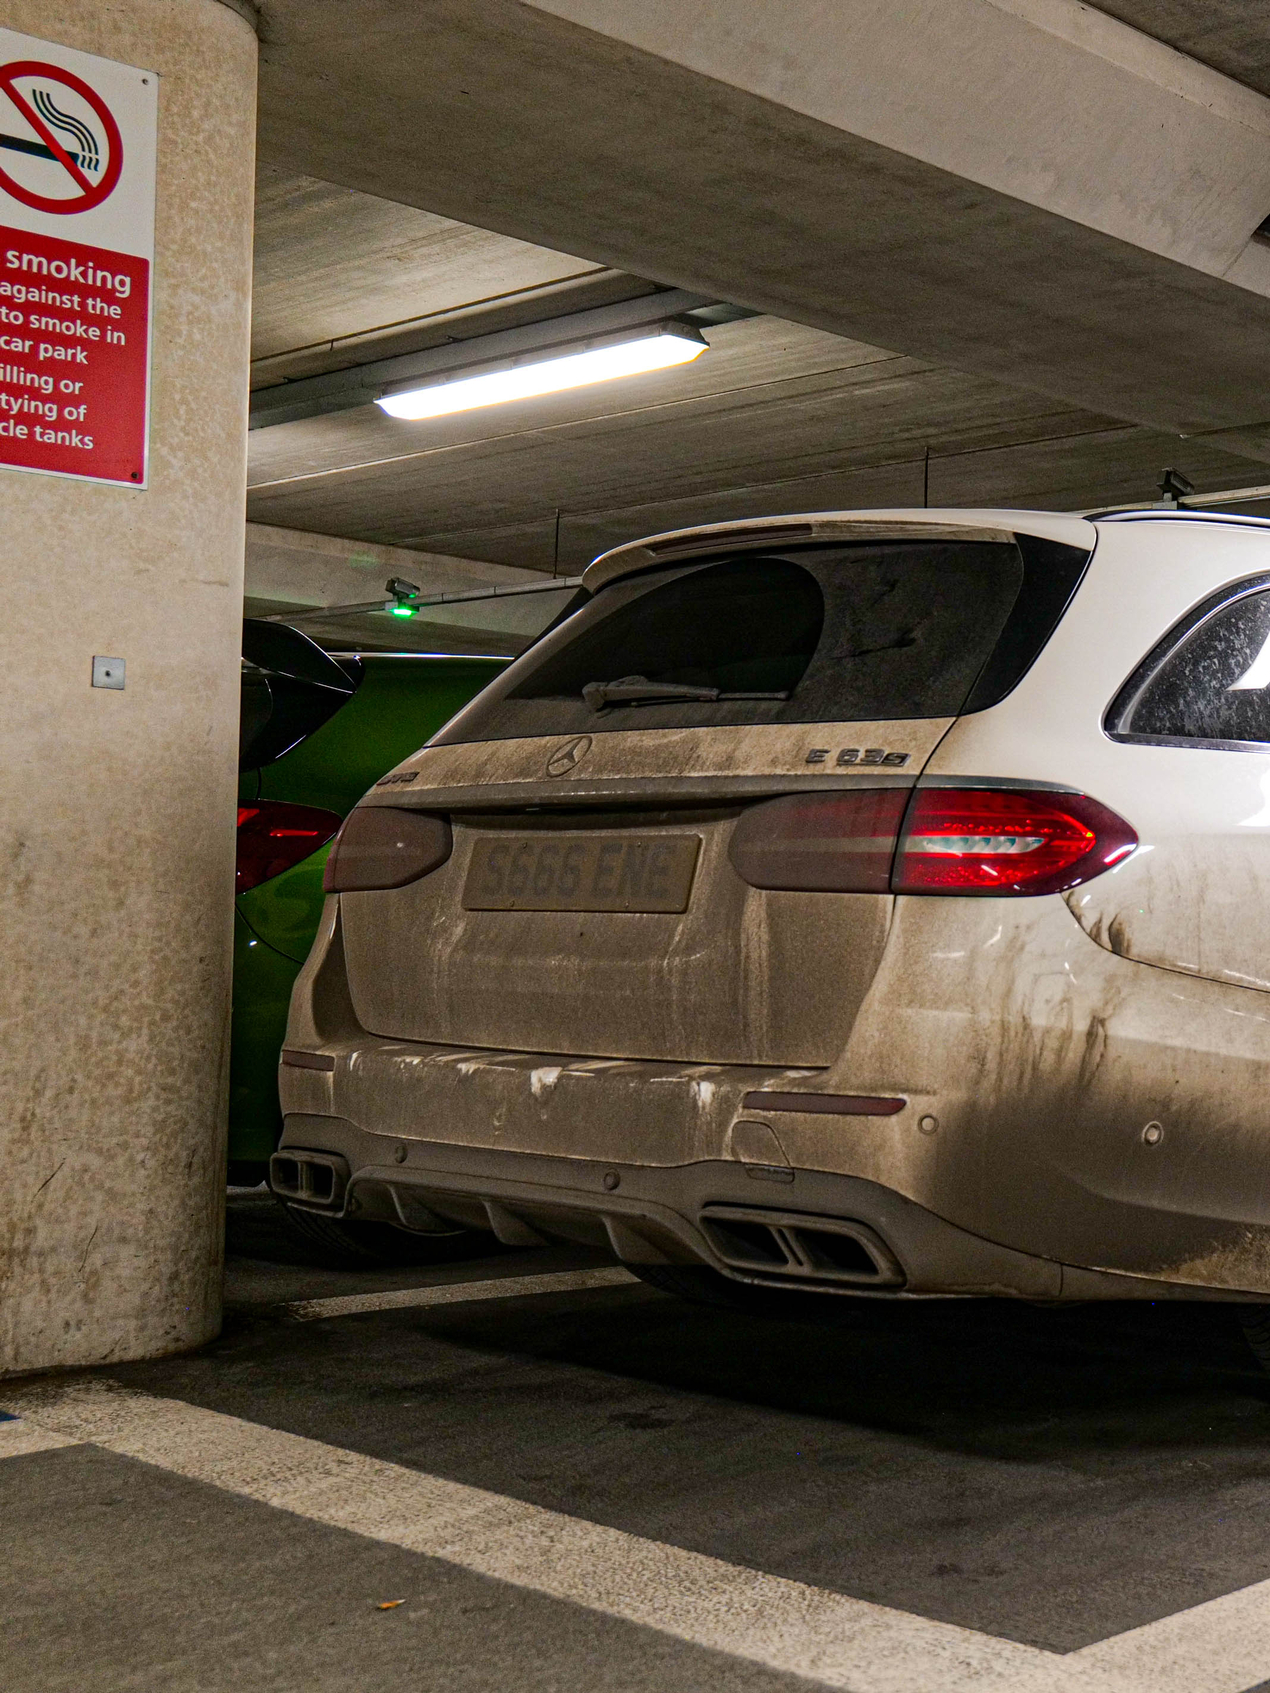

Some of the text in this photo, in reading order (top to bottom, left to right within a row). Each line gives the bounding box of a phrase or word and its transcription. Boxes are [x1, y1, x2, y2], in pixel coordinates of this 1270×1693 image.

[6, 249, 131, 298] smoking
[0, 281, 122, 319] against the
[0, 305, 126, 346] to smoke in
[0, 335, 88, 365] car park
[59, 378, 84, 395] or
[0, 392, 87, 422] tying of
[0, 419, 94, 450] cle tanks
[805, 748, 831, 763] E
